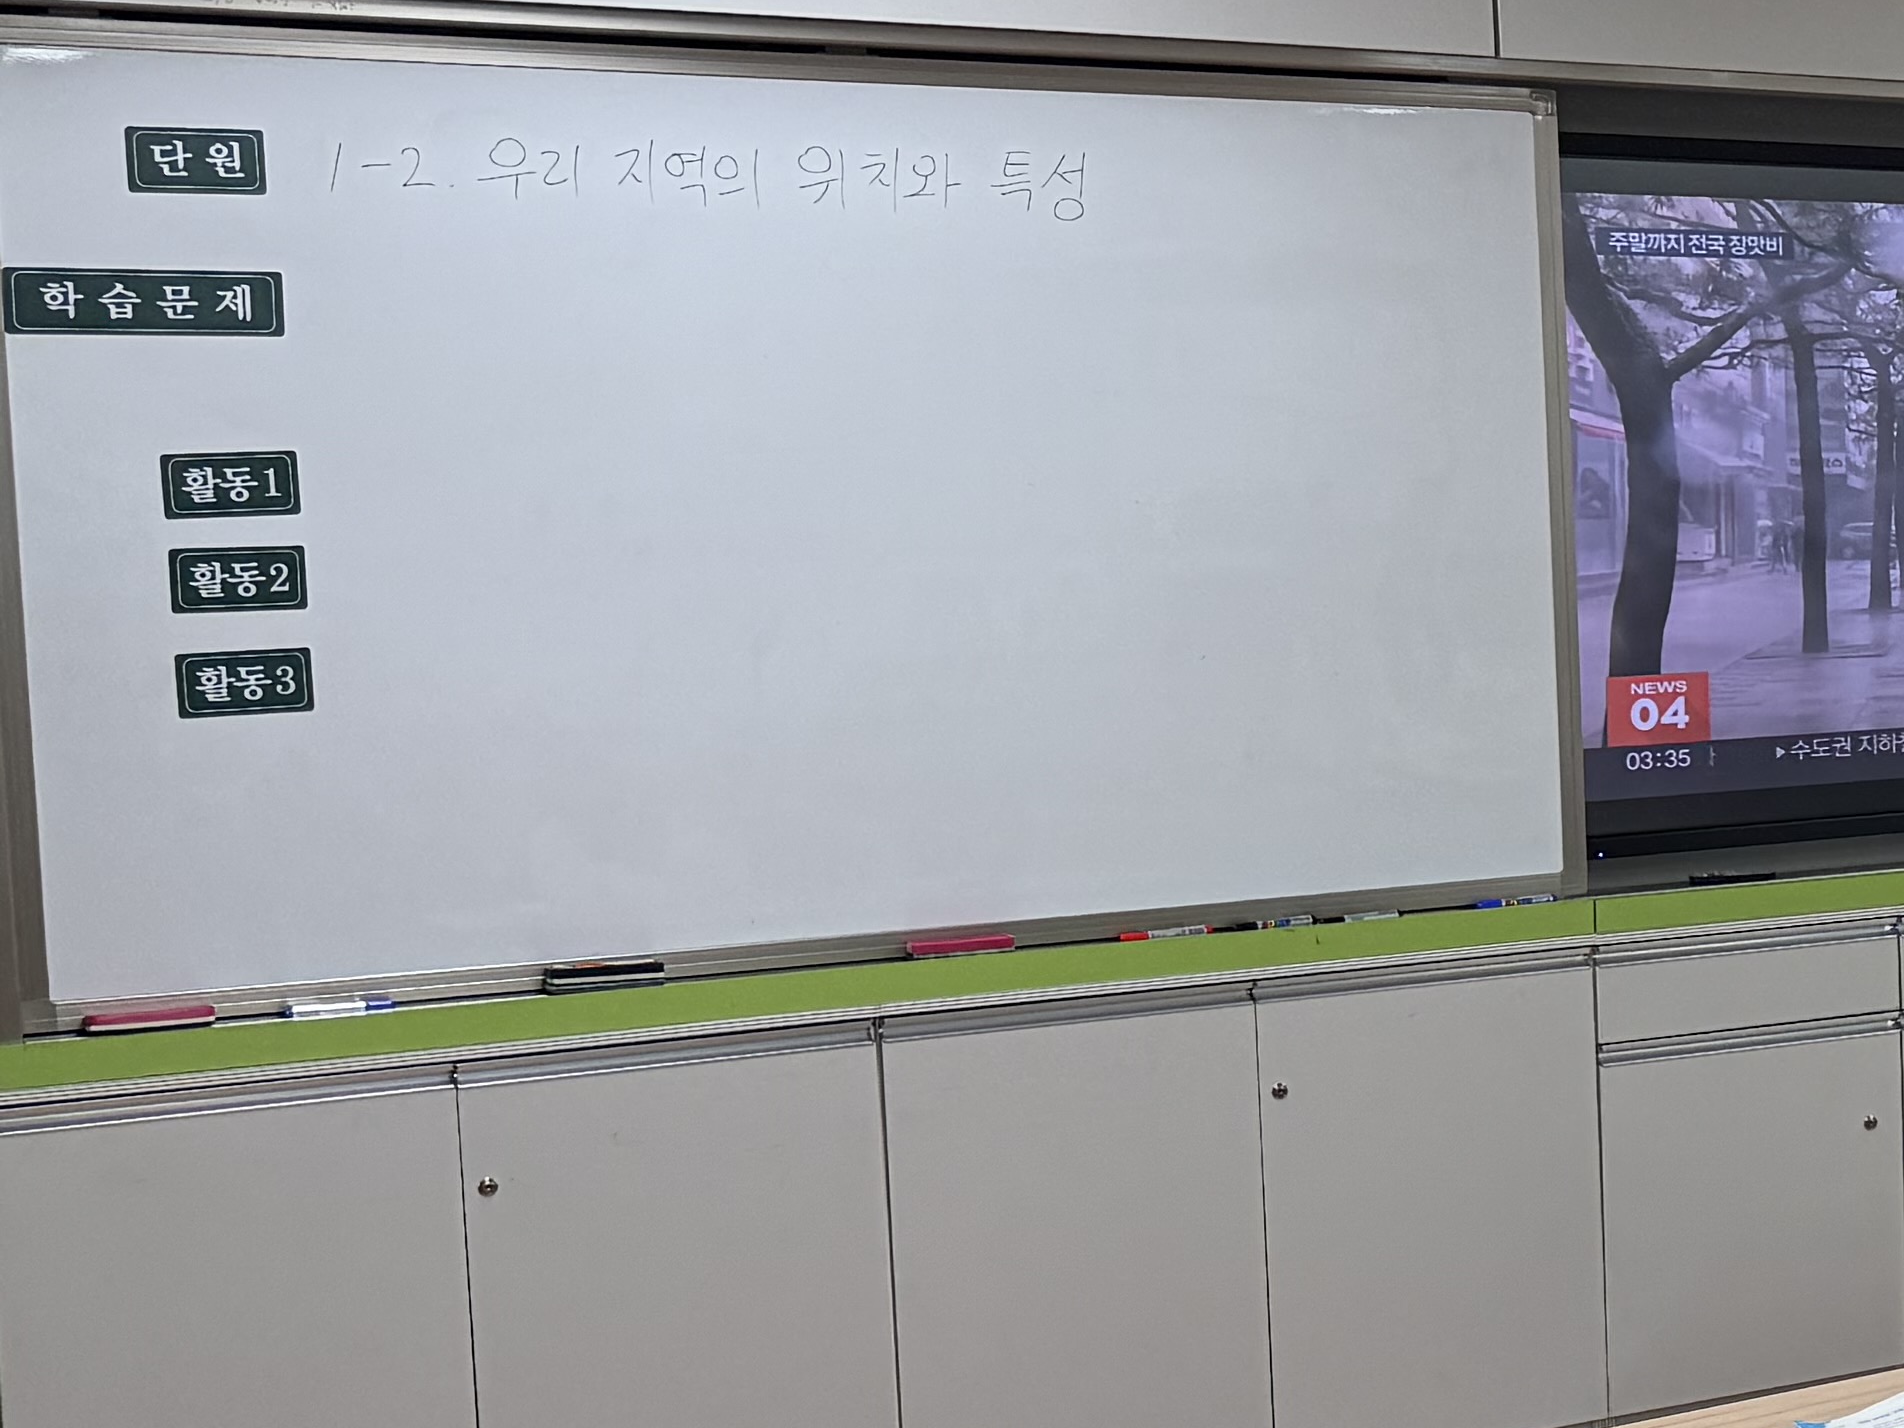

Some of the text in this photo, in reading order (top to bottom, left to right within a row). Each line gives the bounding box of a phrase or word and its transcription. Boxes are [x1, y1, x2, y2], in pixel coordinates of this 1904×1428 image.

[149, 139, 246, 178] 단원
[477, 137, 580, 200] 우리
[614, 139, 760, 210] 지역의
[798, 146, 962, 213] 위치와
[990, 151, 1086, 221] 특성
[1608, 231, 1783, 256] 주말까지 전국 장맛비
[181, 466, 282, 503] 활동1
[189, 561, 290, 598] 활동2
[195, 665, 296, 702] 활동3
[1630, 680, 1688, 695] NEWS
[1630, 695, 1691, 732] 04
[1625, 748, 1692, 771] 03:35
[1789, 736, 1852, 761] 수도권
